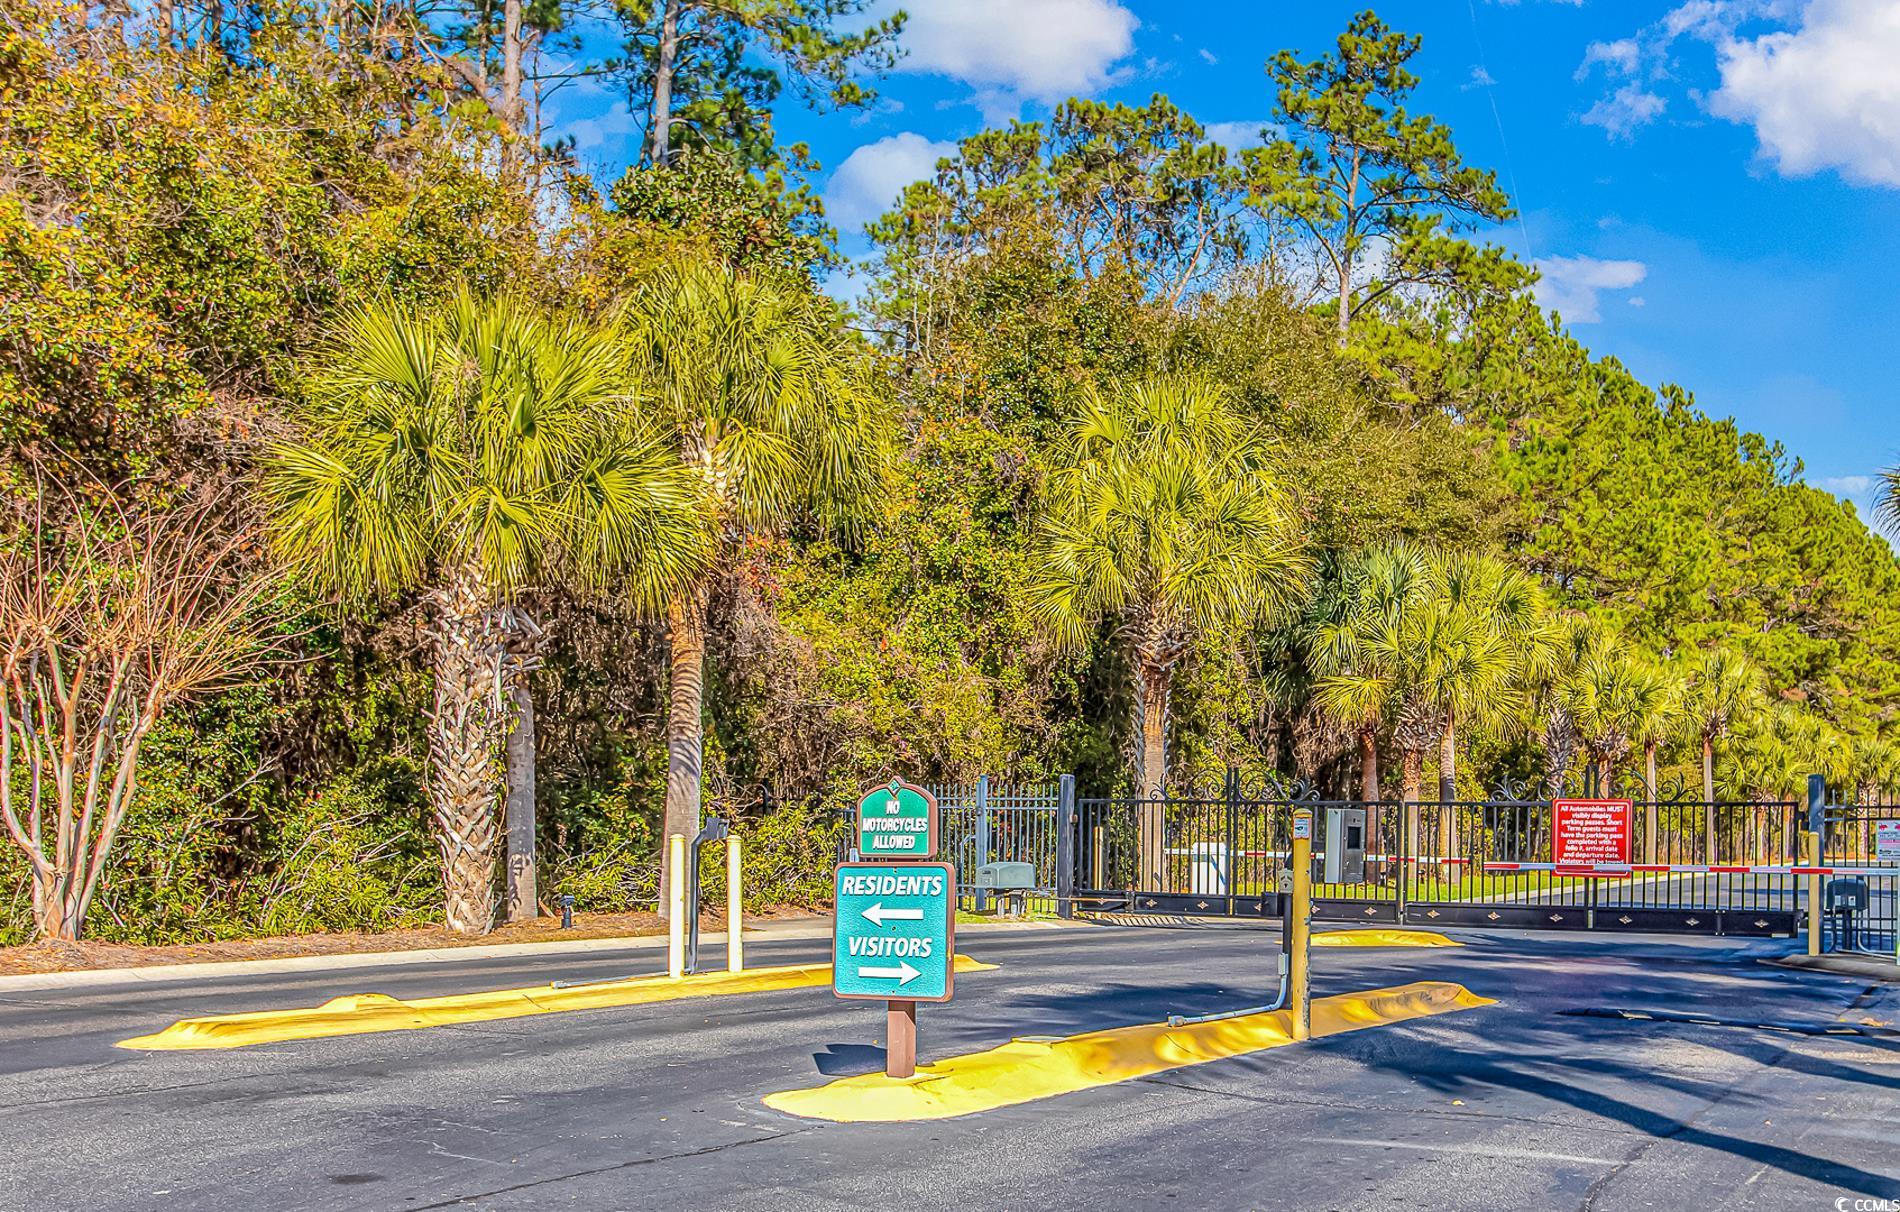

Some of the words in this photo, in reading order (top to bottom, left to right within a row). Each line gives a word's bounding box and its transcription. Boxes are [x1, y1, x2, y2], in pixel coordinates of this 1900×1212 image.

[886, 800, 900, 815] NO
[862, 817, 928, 832] MOTORCYCLES
[872, 835, 916, 850] ALLOWED
[842, 875, 943, 896] RESIDENTS
[848, 936, 933, 957] VISITORS
